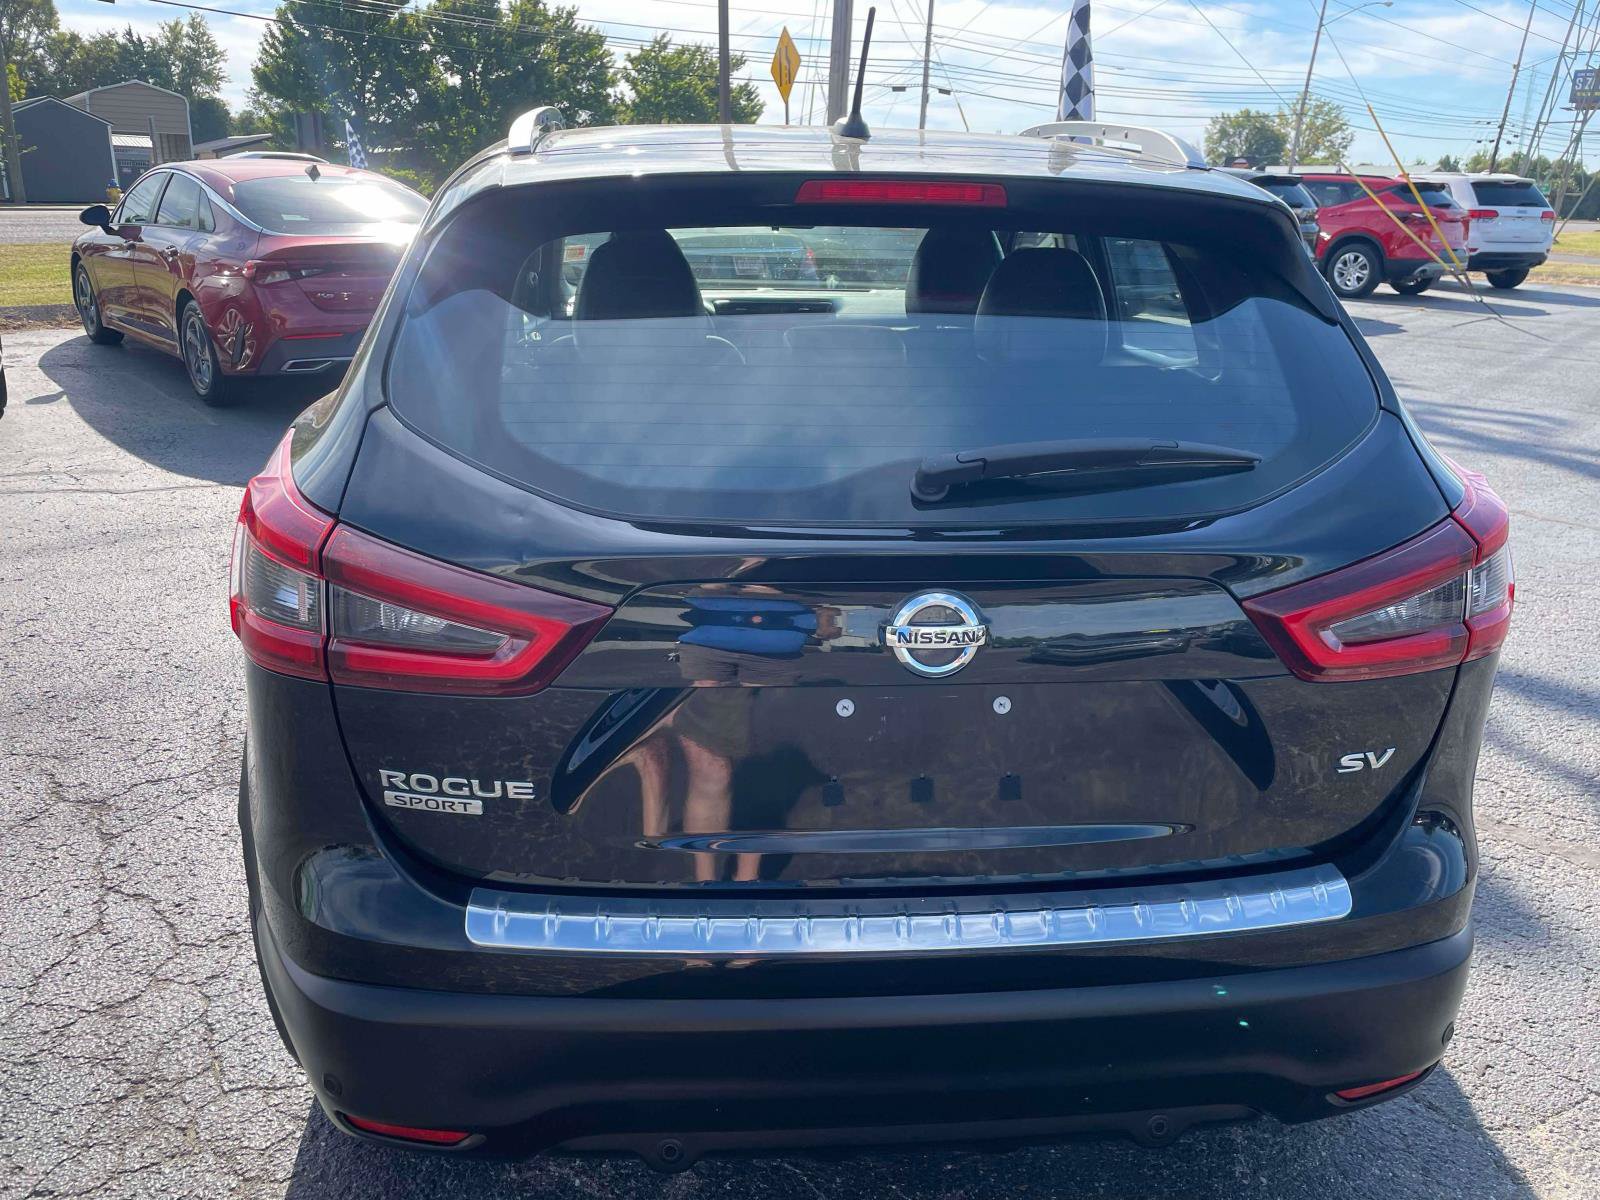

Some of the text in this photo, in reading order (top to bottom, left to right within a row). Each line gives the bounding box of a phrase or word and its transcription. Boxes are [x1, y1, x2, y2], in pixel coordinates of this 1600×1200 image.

[897, 630, 976, 644] NISSAN
[1336, 747, 1396, 774] SV
[378, 768, 536, 800] ROGUE
[393, 794, 473, 813] SPORT
